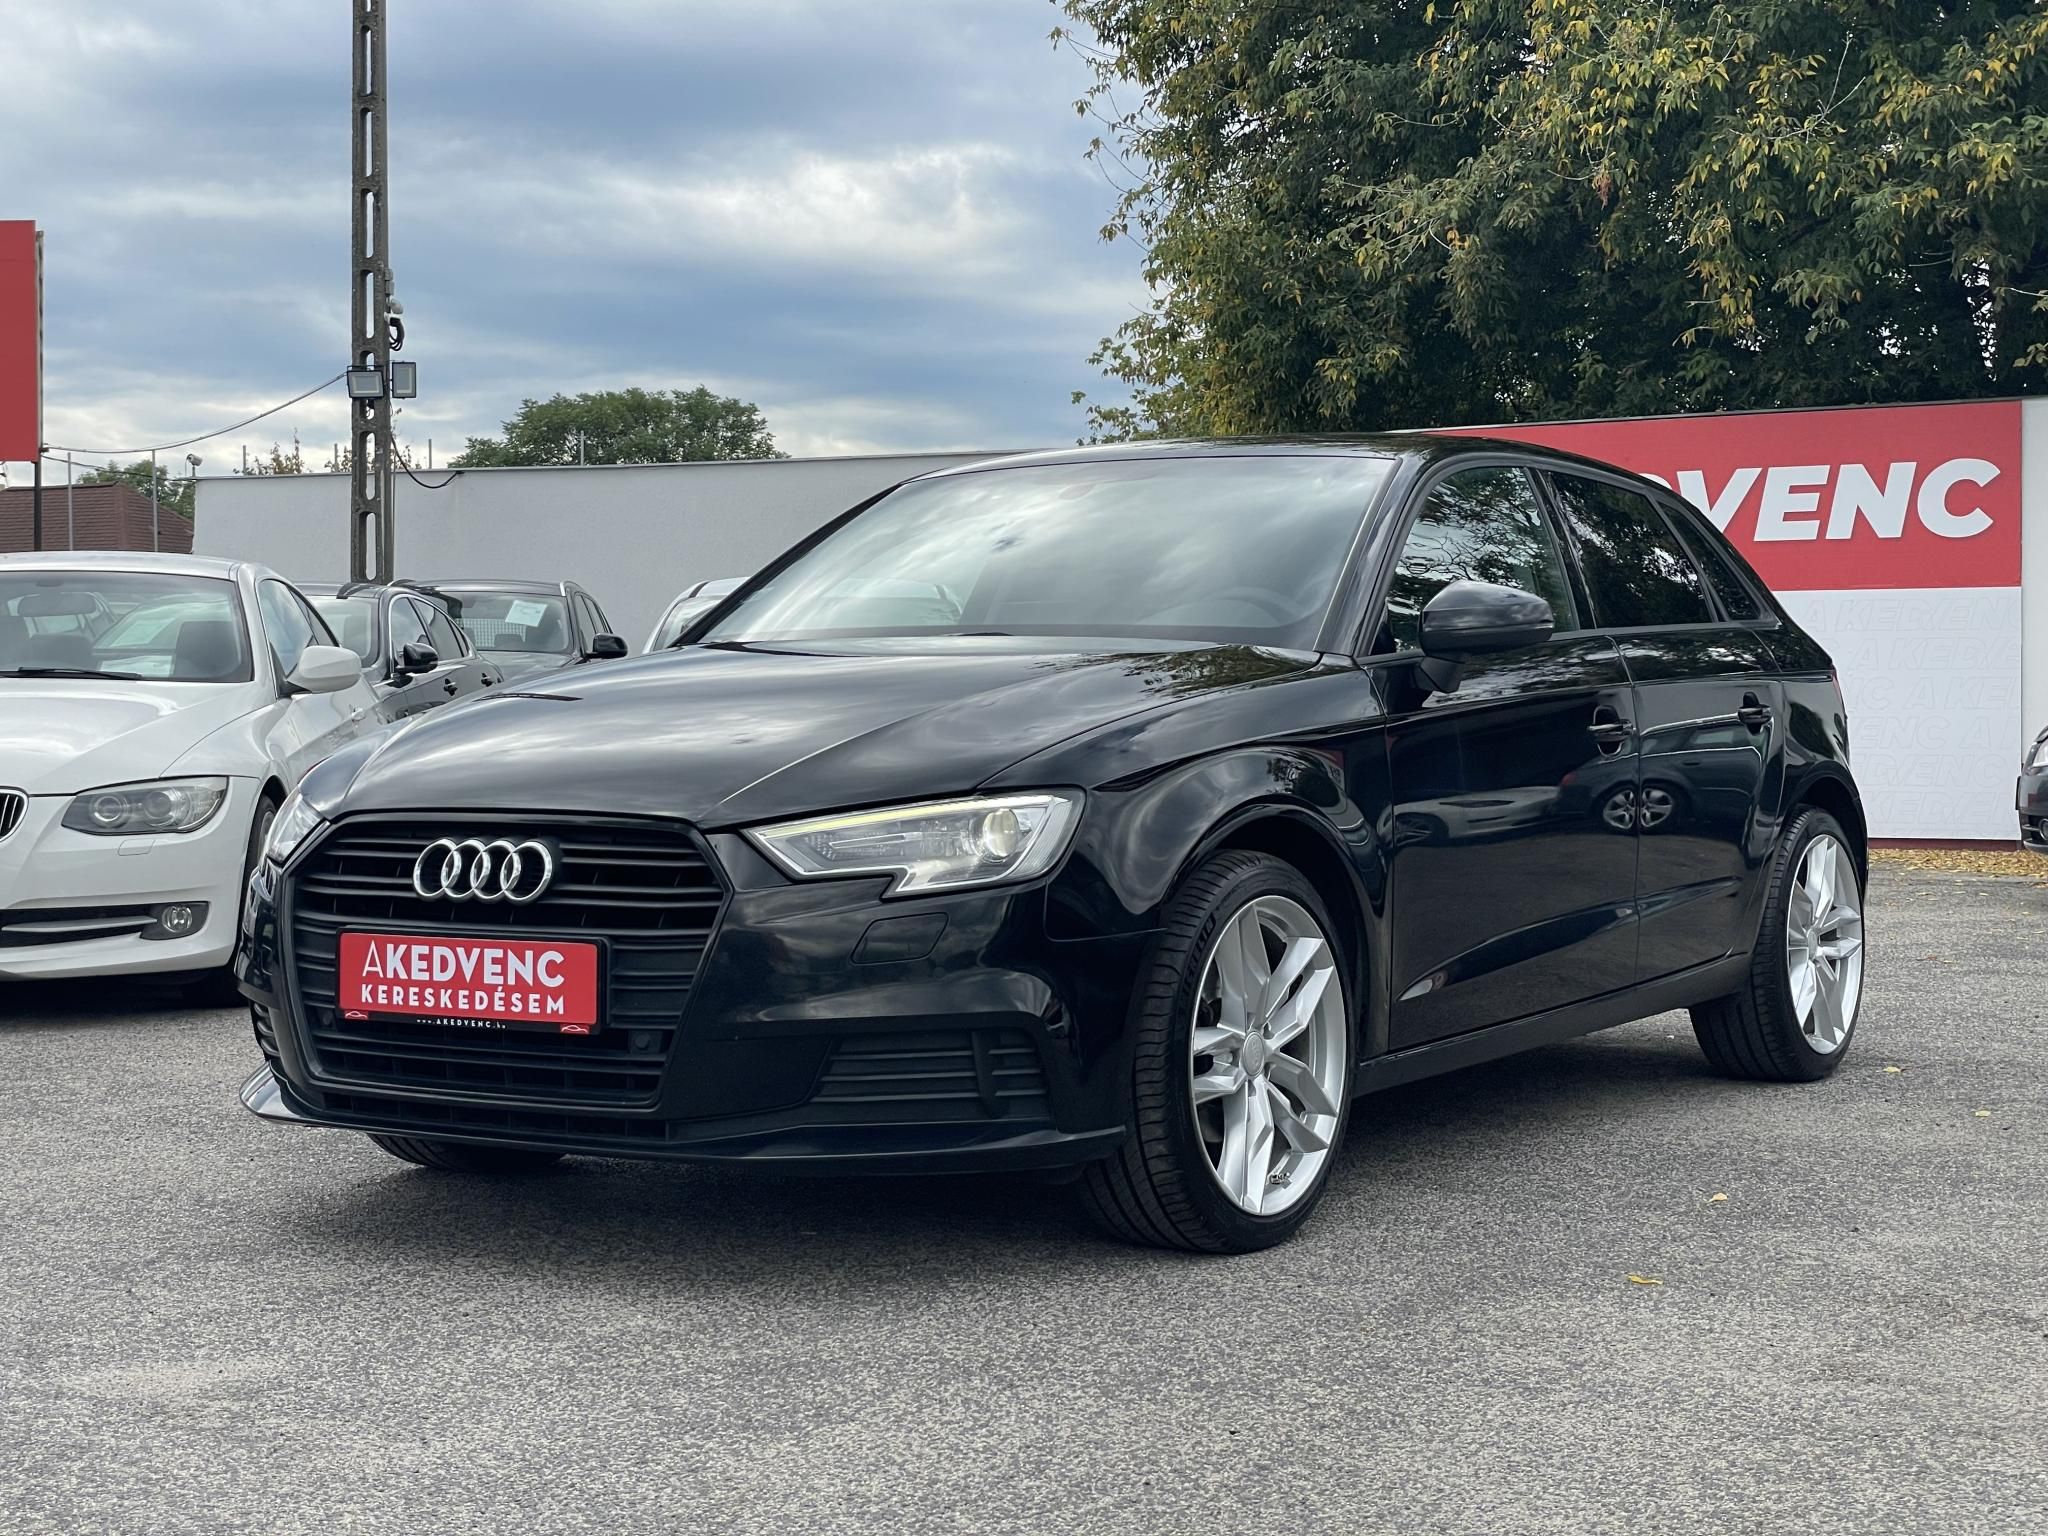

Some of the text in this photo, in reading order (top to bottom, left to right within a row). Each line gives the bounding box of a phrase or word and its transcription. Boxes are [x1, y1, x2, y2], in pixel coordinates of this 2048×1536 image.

[1639, 458, 2001, 541] VENC
[1944, 676, 2020, 710] KE
[362, 940, 565, 988] AKEDVENC
[361, 984, 565, 1014] KERESKEDÉSEM
